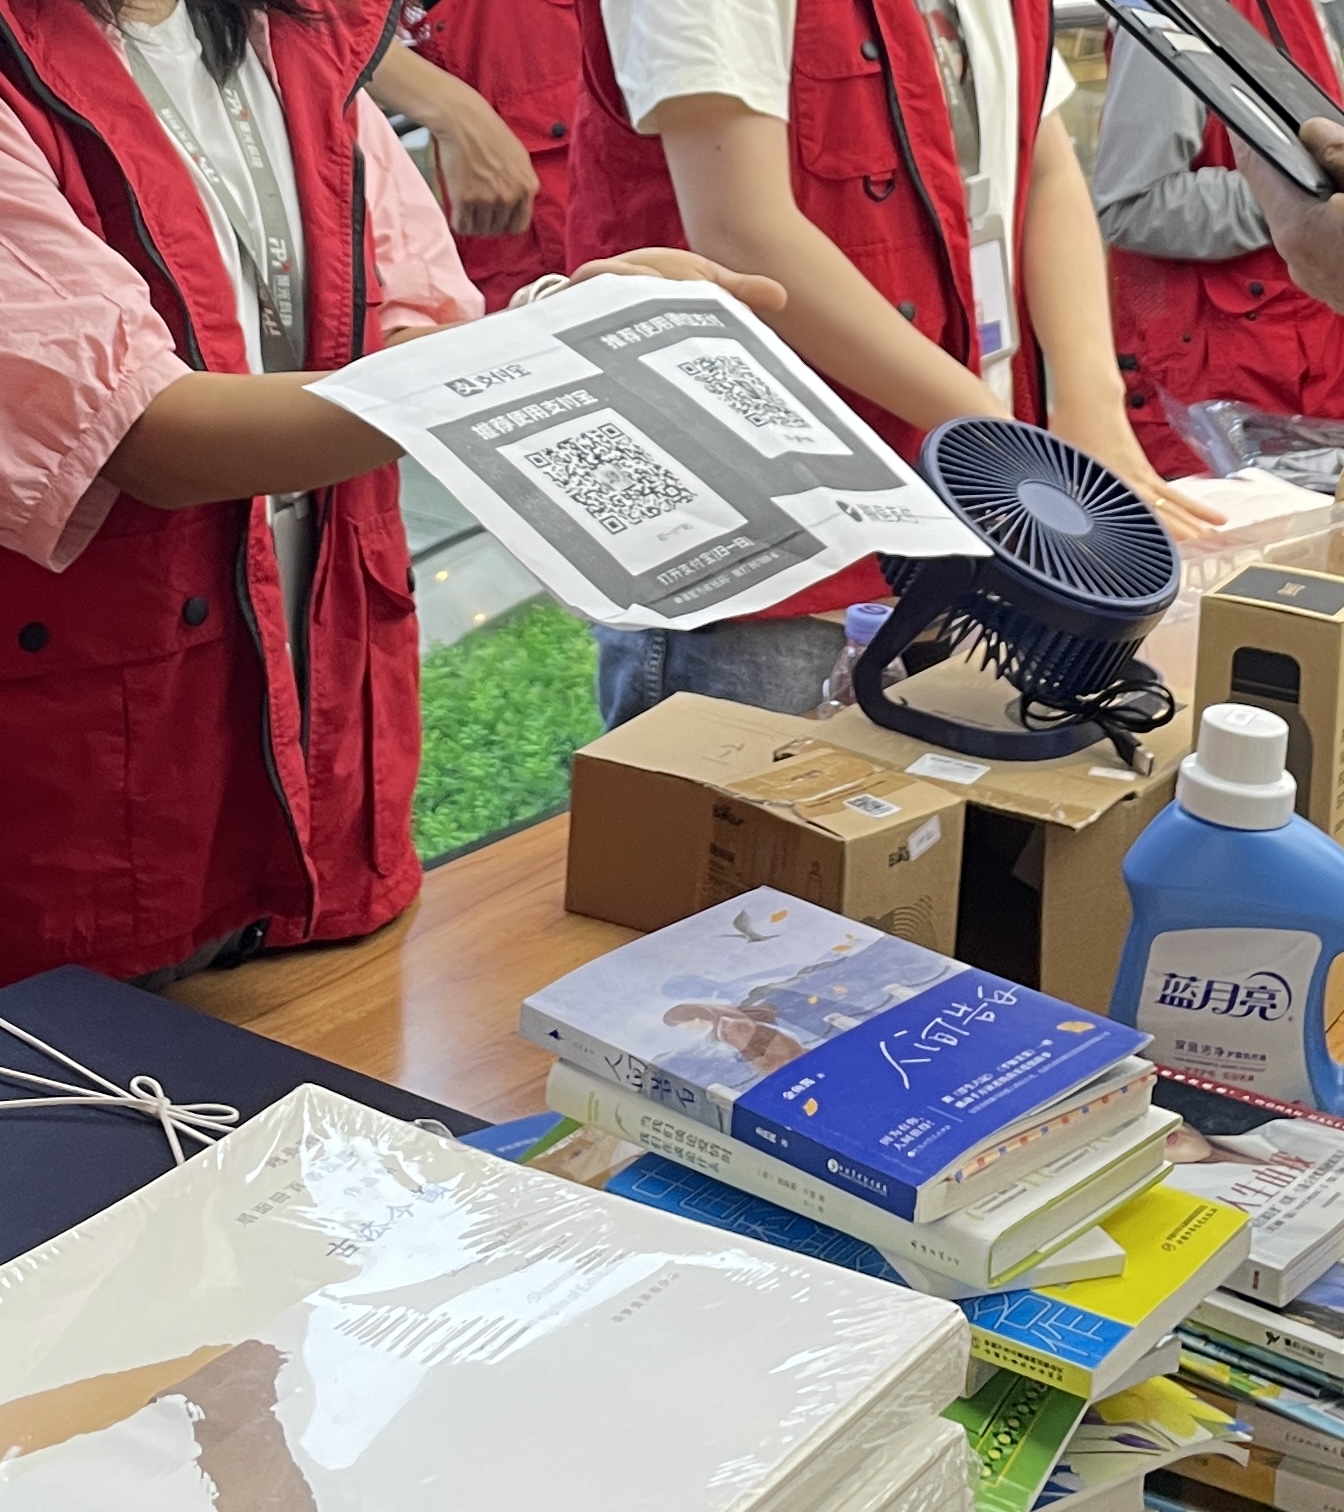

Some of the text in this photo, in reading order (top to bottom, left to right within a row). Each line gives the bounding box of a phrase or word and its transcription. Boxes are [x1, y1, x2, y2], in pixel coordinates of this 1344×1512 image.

[471, 389, 599, 440] 推荐使用支付宝
[1155, 971, 1292, 1021] 蓝月亮
